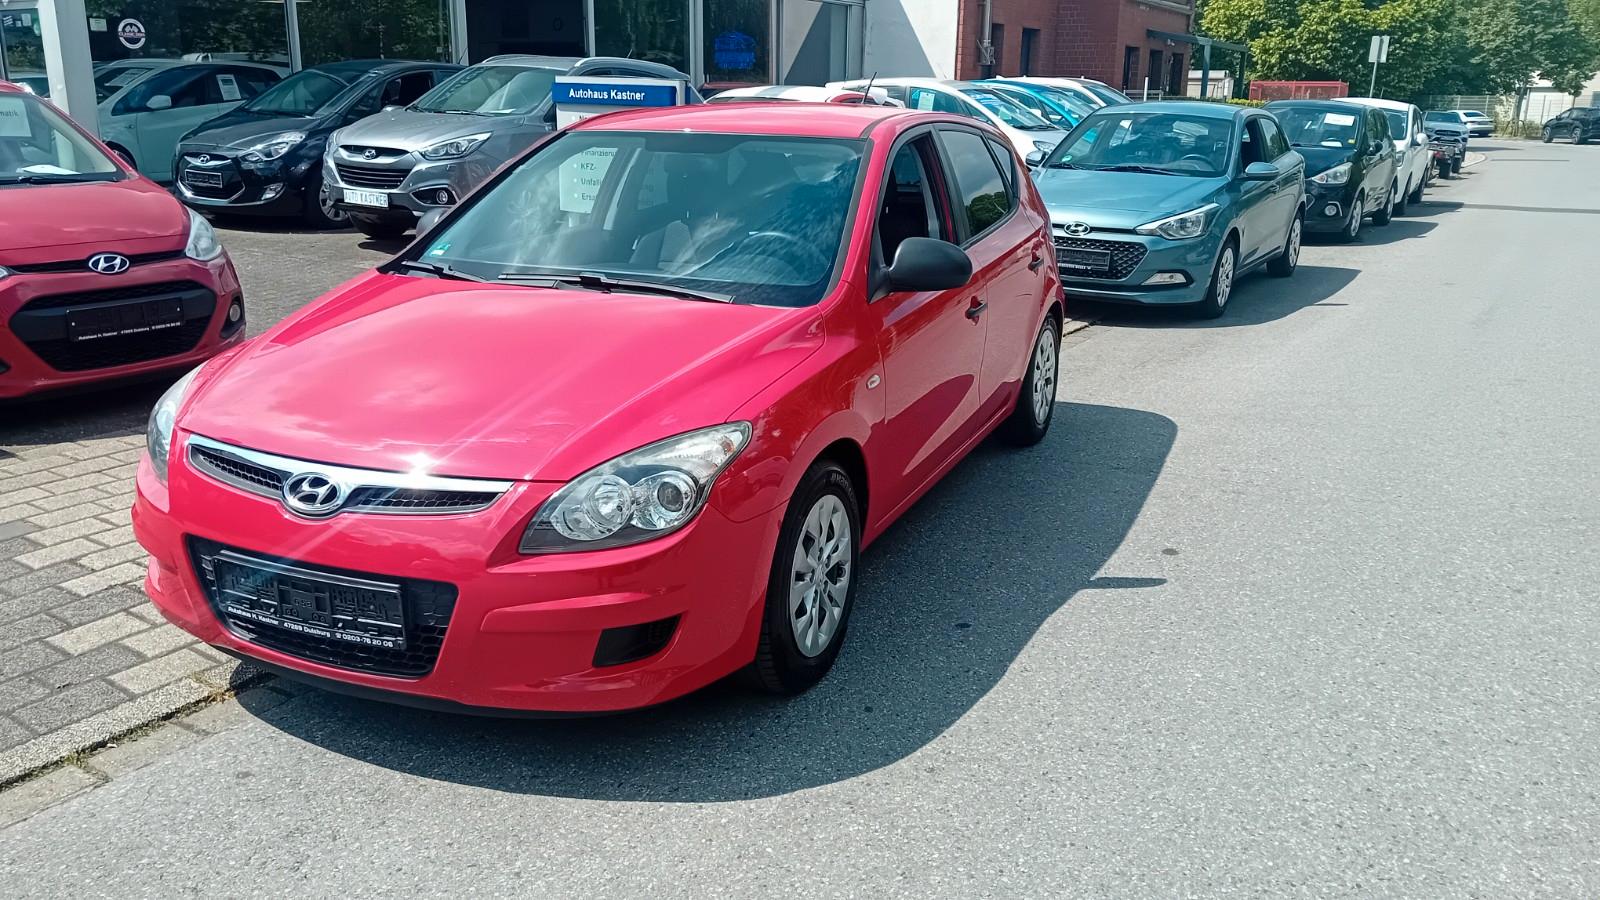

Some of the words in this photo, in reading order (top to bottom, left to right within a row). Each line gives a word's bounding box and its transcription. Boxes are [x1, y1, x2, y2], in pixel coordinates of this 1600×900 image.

[569, 88, 608, 99] Autohaus
[610, 90, 645, 100] Kastner
[580, 162, 597, 171] KFZ-
[345, 191, 358, 202] AUTO
[360, 193, 388, 206] KASTNER
[227, 606, 252, 618] Autohaus
[258, 616, 279, 626] Kastner
[303, 626, 331, 638] Duisburg
